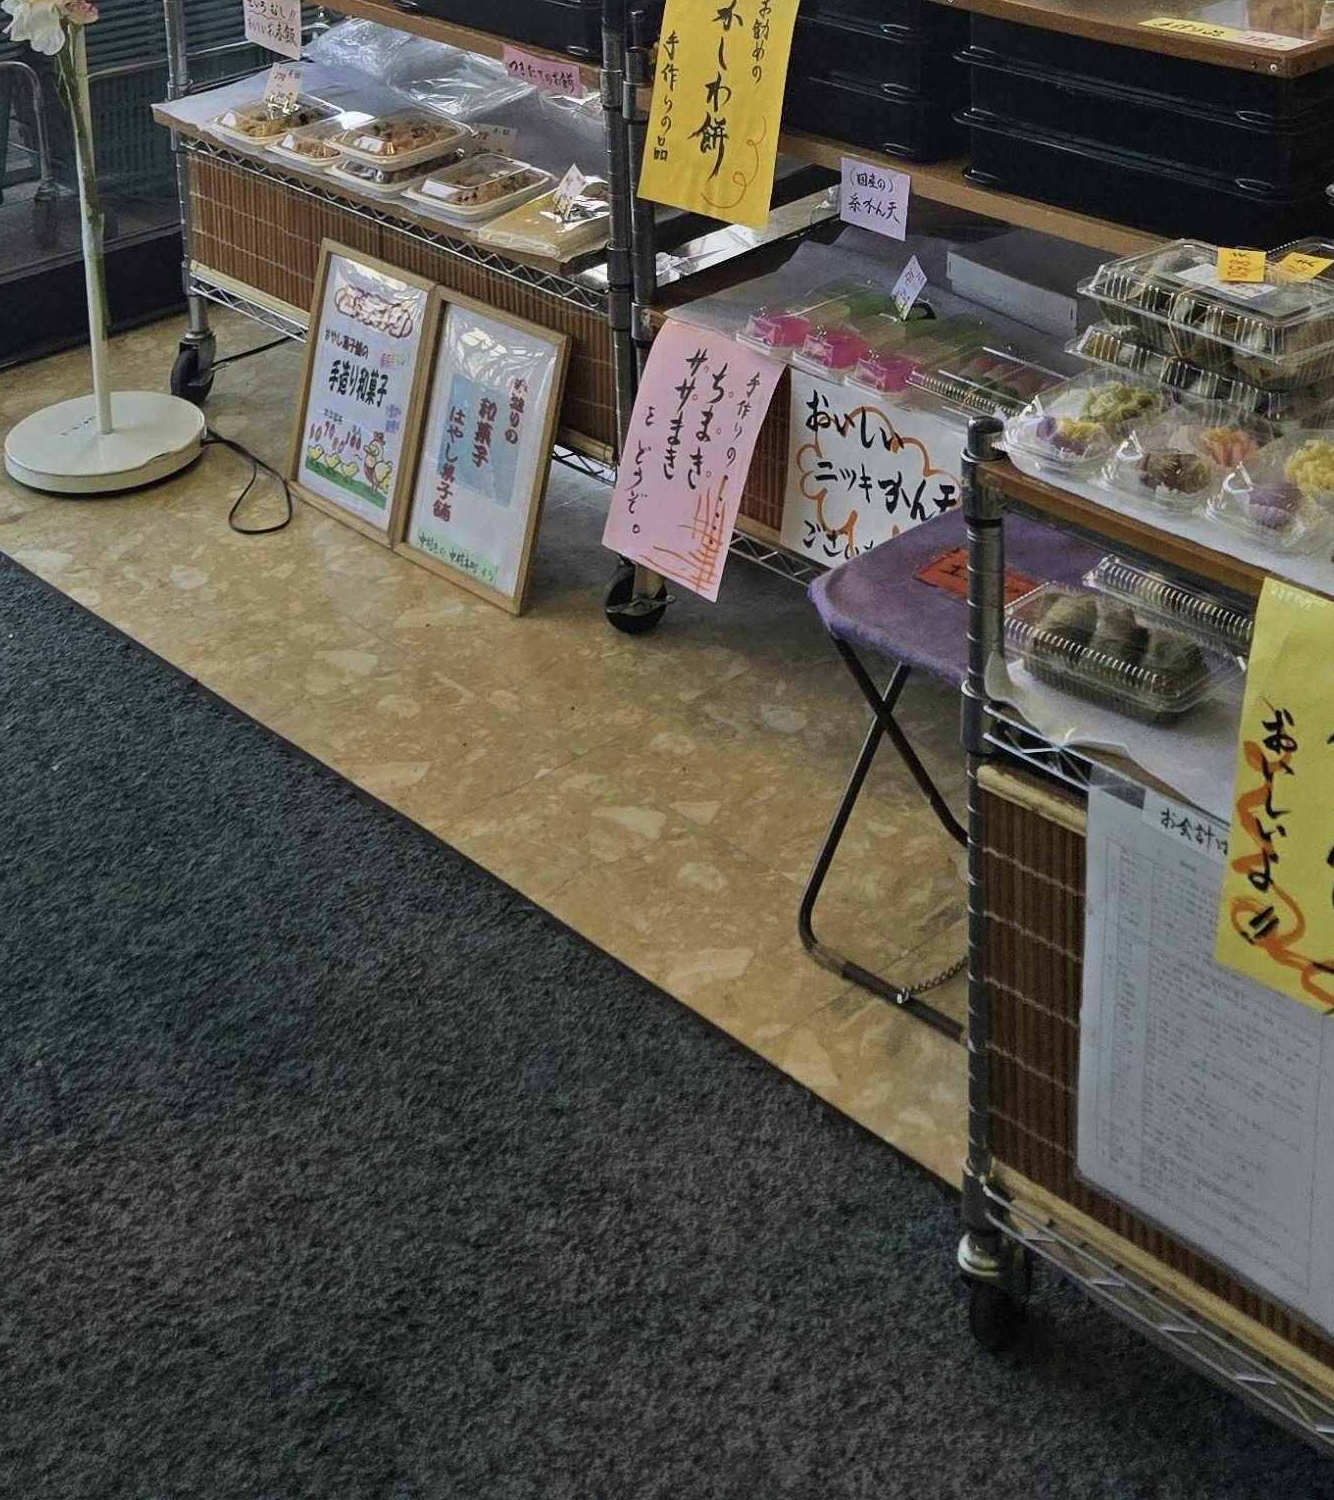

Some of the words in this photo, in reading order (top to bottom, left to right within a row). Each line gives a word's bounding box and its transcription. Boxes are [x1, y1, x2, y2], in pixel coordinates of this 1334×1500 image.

[653, 28, 681, 162] 手作りの品
[687, 361, 730, 492] ちまき
[805, 388, 906, 453] おいしい
